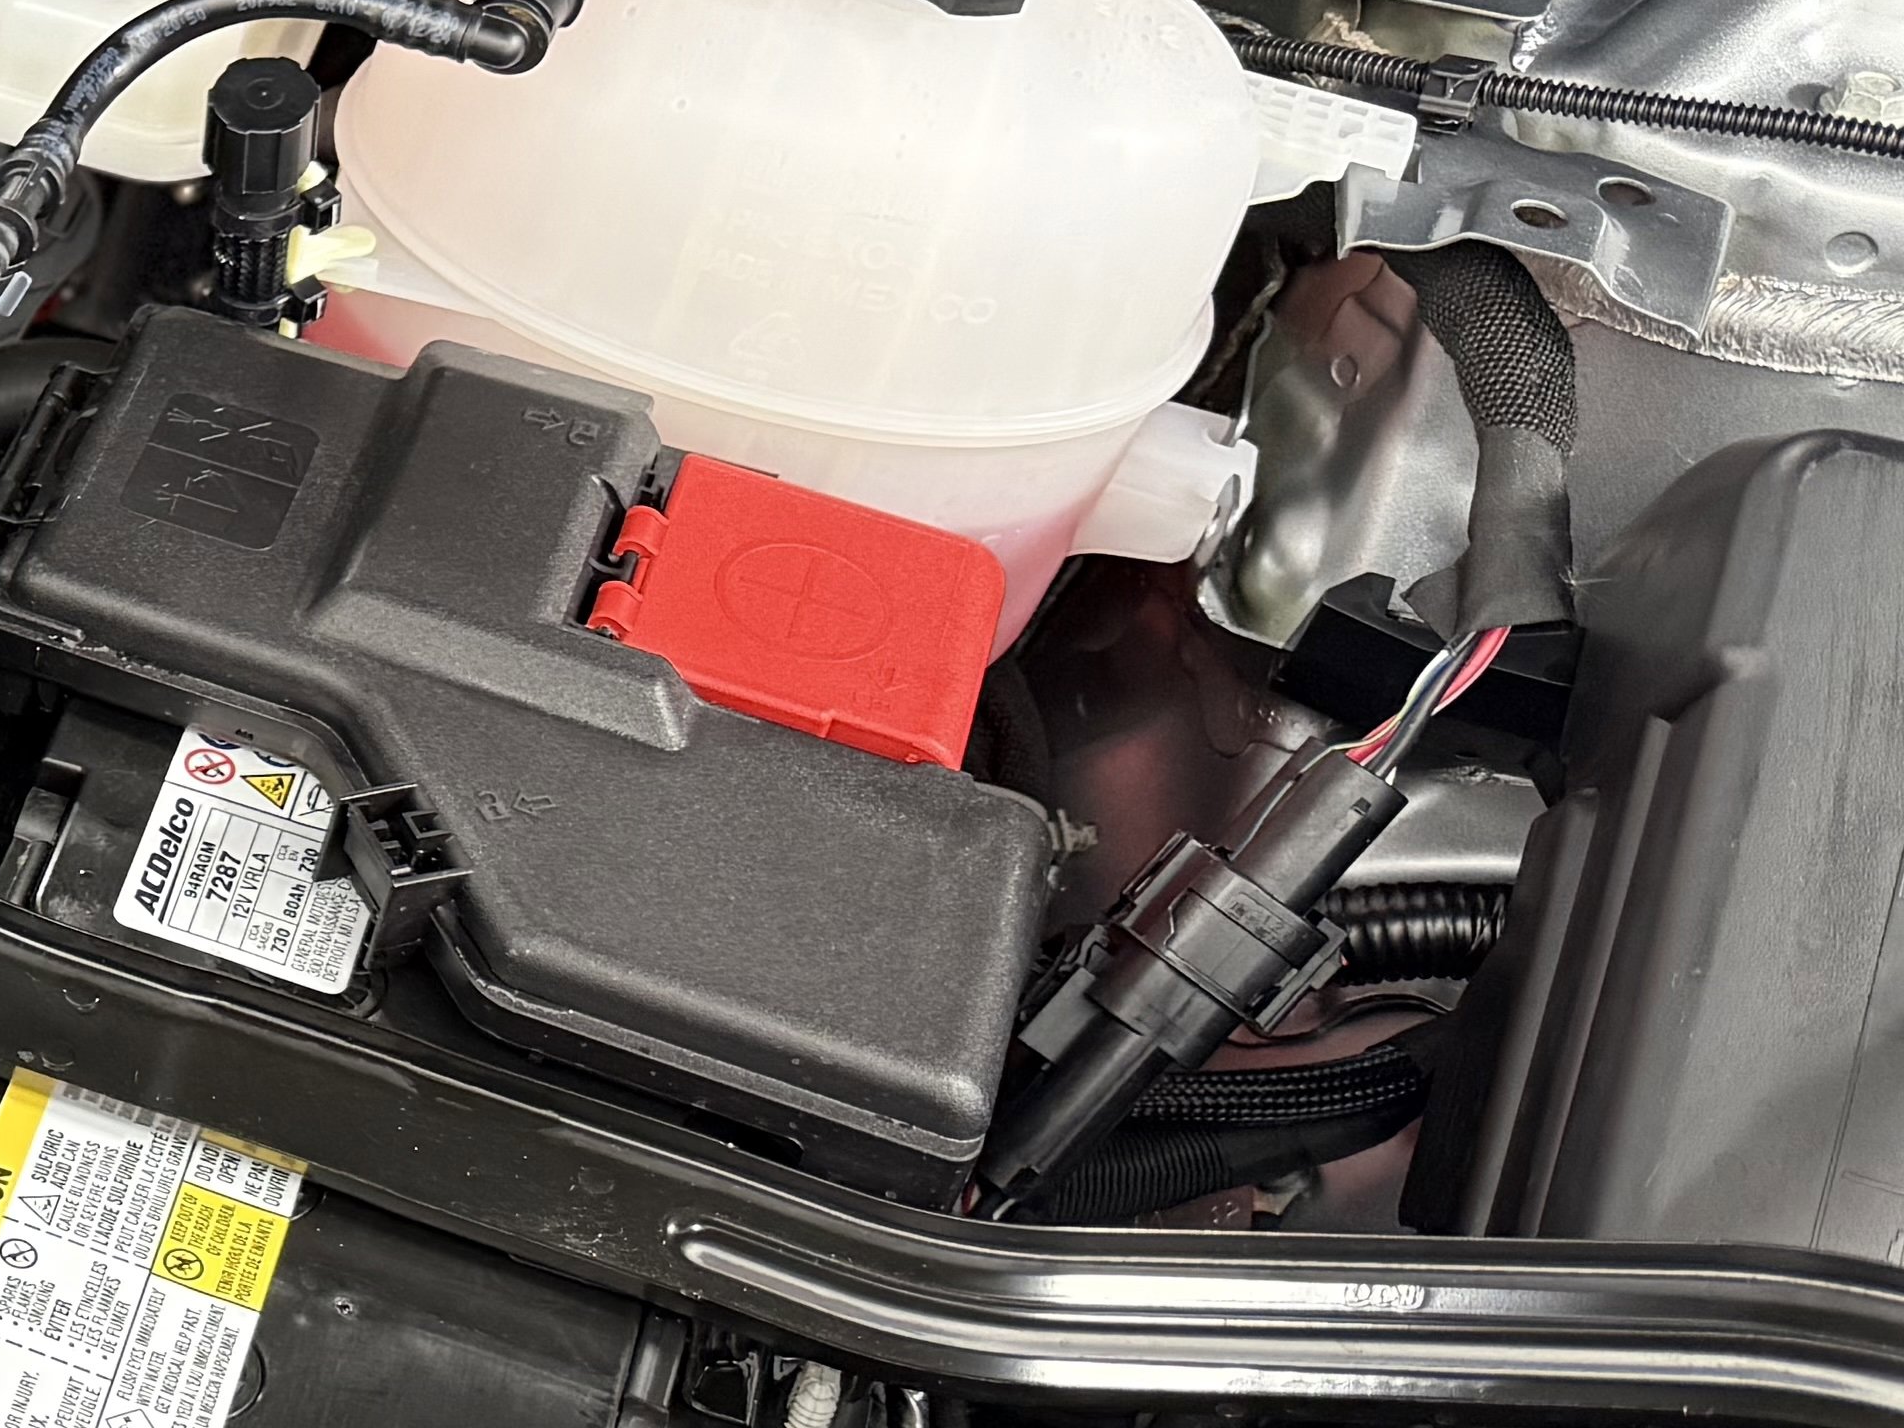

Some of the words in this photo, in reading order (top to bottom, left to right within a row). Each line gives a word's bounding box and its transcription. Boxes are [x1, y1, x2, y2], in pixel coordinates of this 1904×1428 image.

[135, 798, 194, 915] ACDelco
[205, 851, 241, 902] 7287
[240, 853, 270, 890] VRLA
[232, 894, 253, 919] 12V
[270, 928, 291, 953] 730
[283, 884, 306, 918] 80Ah
[298, 848, 322, 873] 730
[337, 924, 353, 937] MI
[291, 929, 321, 972] GENERAL
[306, 958, 324, 977] 300
[31, 1129, 64, 1183] SULFURIC
[50, 1161, 72, 1190] ACID
[61, 1140, 81, 1162] CAN
[139, 1169, 156, 1183] LA
[194, 1164, 214, 1182] DO
[56, 1197, 79, 1232] CAUSE
[68, 1141, 100, 1197] BLINDNESS
[92, 1205, 120, 1246] L'ACIDE
[107, 1140, 143, 1205] SULFURIQUE
[243, 1181, 262, 1197] NE
[80, 1182, 106, 1222] SEVERE
[124, 1183, 151, 1225] CAUSER
[177, 1203, 194, 1222] OUT
[74, 1222, 92, 1238] OR
[114, 1225, 135, 1254] PEUT
[139, 1222, 158, 1243] DES
[170, 1221, 188, 1243] KEEP
[236, 1221, 252, 1234] LA
[132, 1243, 150, 1260] OU
[187, 1232, 206, 1249] THE
[206, 1243, 222, 1256] OF
[67, 1321, 86, 1341] LES
[106, 1300, 131, 1337] FUMER
[84, 1327, 103, 1347] LES
[100, 1339, 118, 1354] DE
[126, 1347, 146, 1370] EYES
[116, 1369, 138, 1401] FLUSH
[154, 1395, 172, 1414] GET
[173, 1332, 192, 1356] HELP
[11, 1371, 39, 1413] INJURY.
[54, 1376, 84, 1428] PEUVENT
